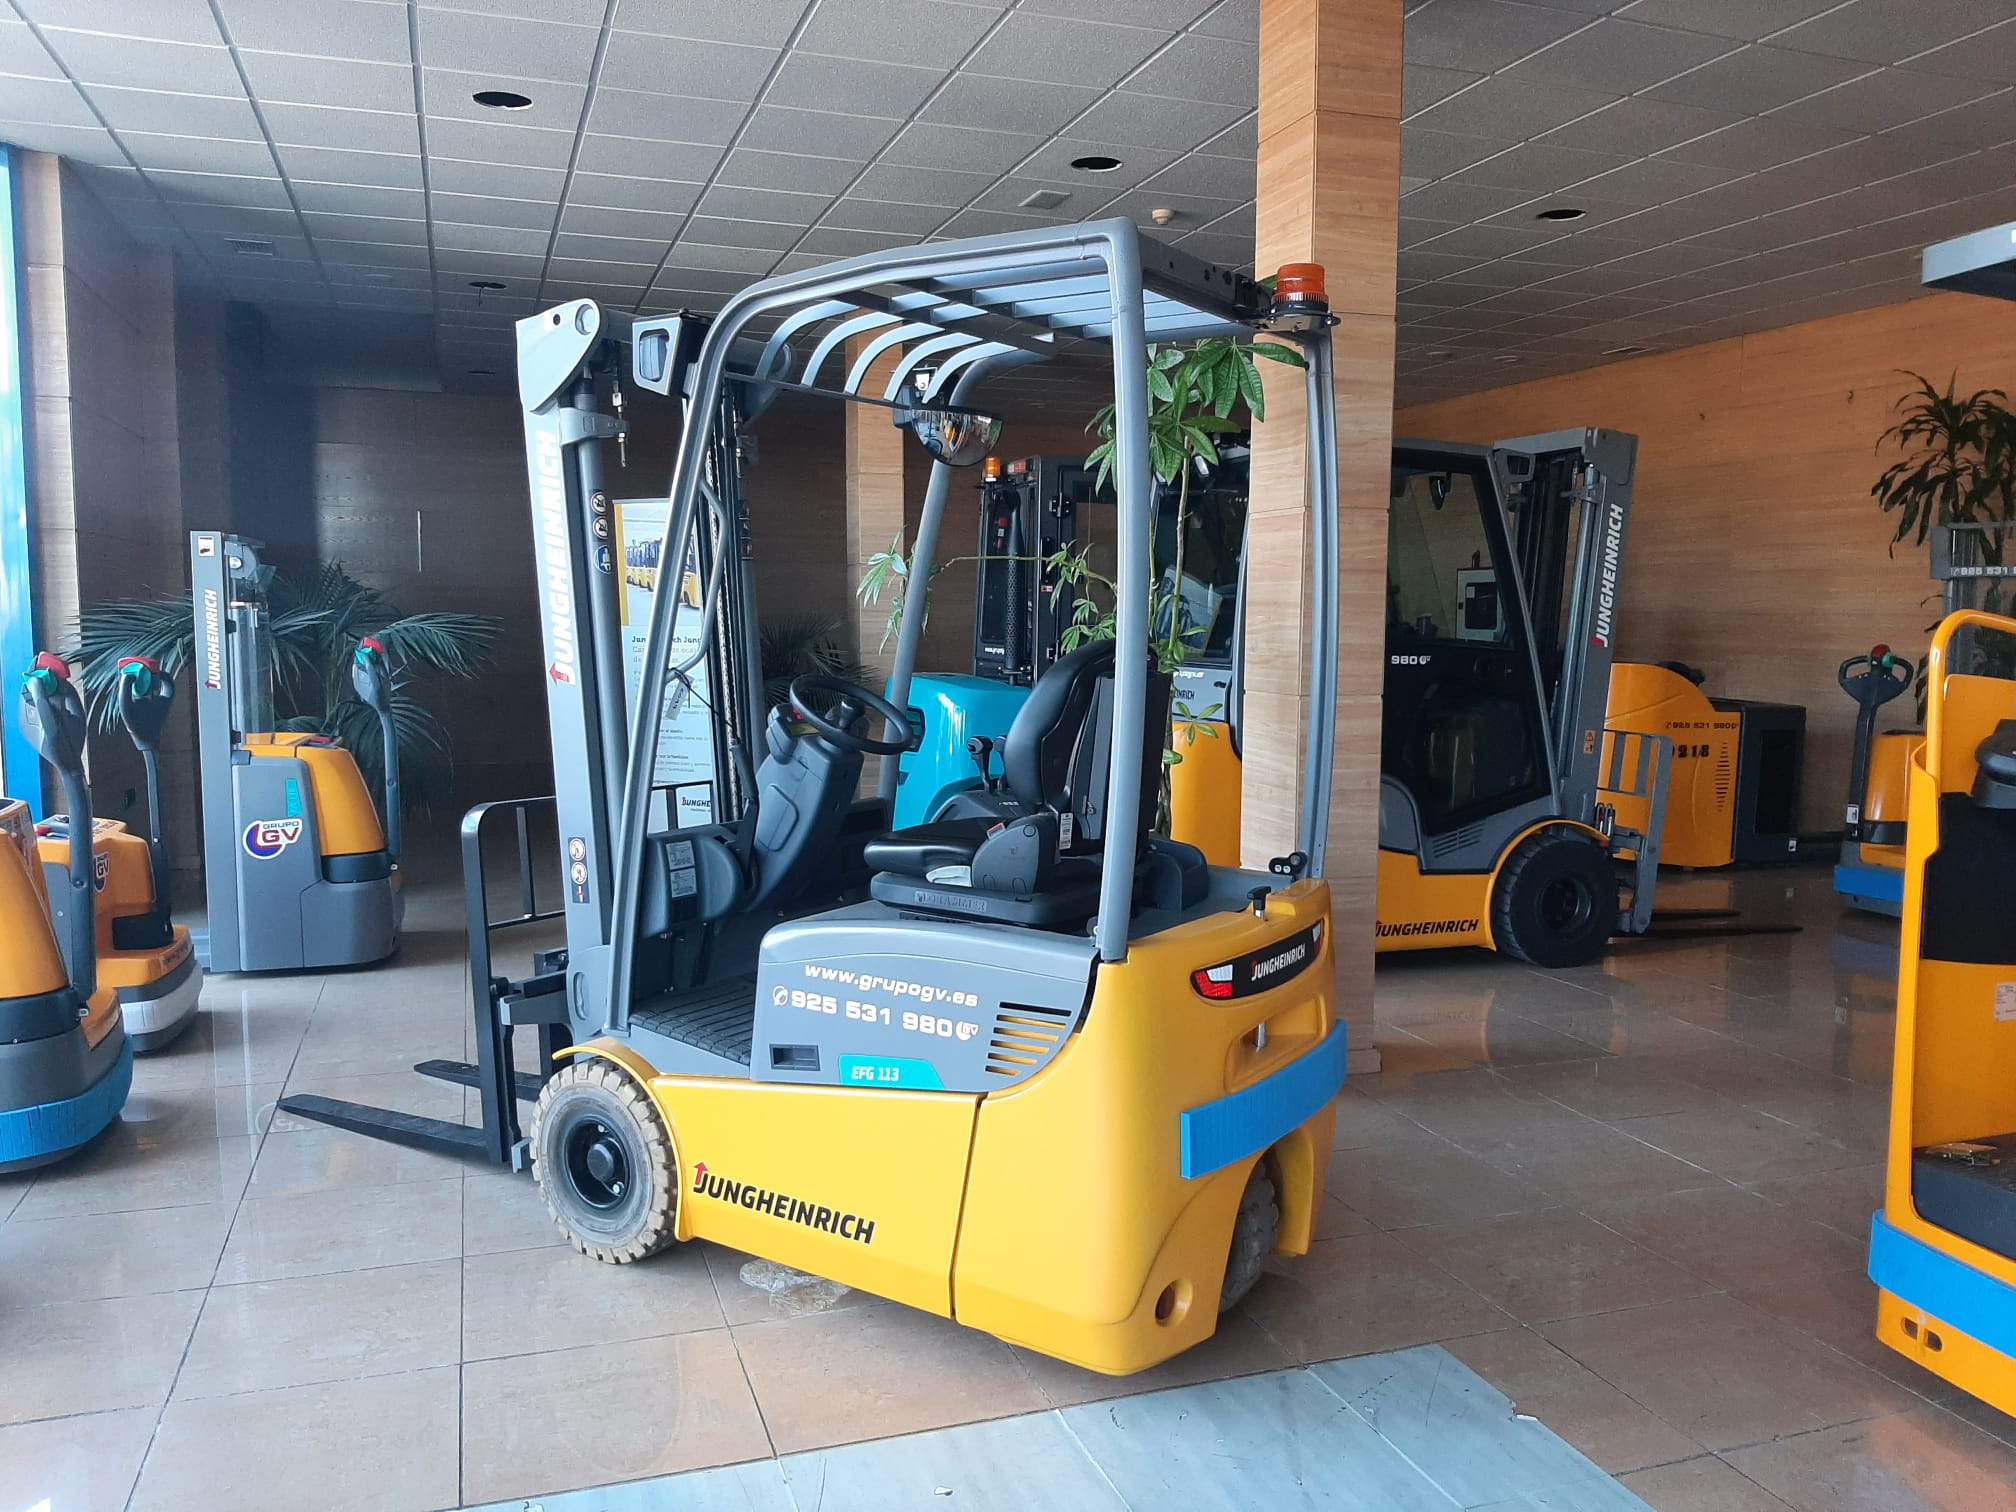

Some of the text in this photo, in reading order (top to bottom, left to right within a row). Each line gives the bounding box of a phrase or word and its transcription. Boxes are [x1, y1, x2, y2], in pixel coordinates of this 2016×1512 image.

[536, 431, 577, 686] JUNGHEINRICH
[1595, 503, 1624, 648] JUNGHEINRICH
[205, 589, 221, 690] JUNGHEINRICH
[1391, 655, 1418, 665] 980
[261, 827, 300, 844] GV
[262, 820, 300, 830] GRUPO
[1376, 919, 1479, 938] JUNGHEINRICH
[1251, 943, 1306, 982] JUNGHEINRICH
[804, 964, 979, 1008] www.grupogv.es
[791, 989, 838, 1015] 925
[845, 1000, 891, 1025] 531
[902, 1011, 953, 1039] 980
[851, 1065, 900, 1082] EFG 113
[693, 1172, 876, 1245] JUNGHEINRICH
